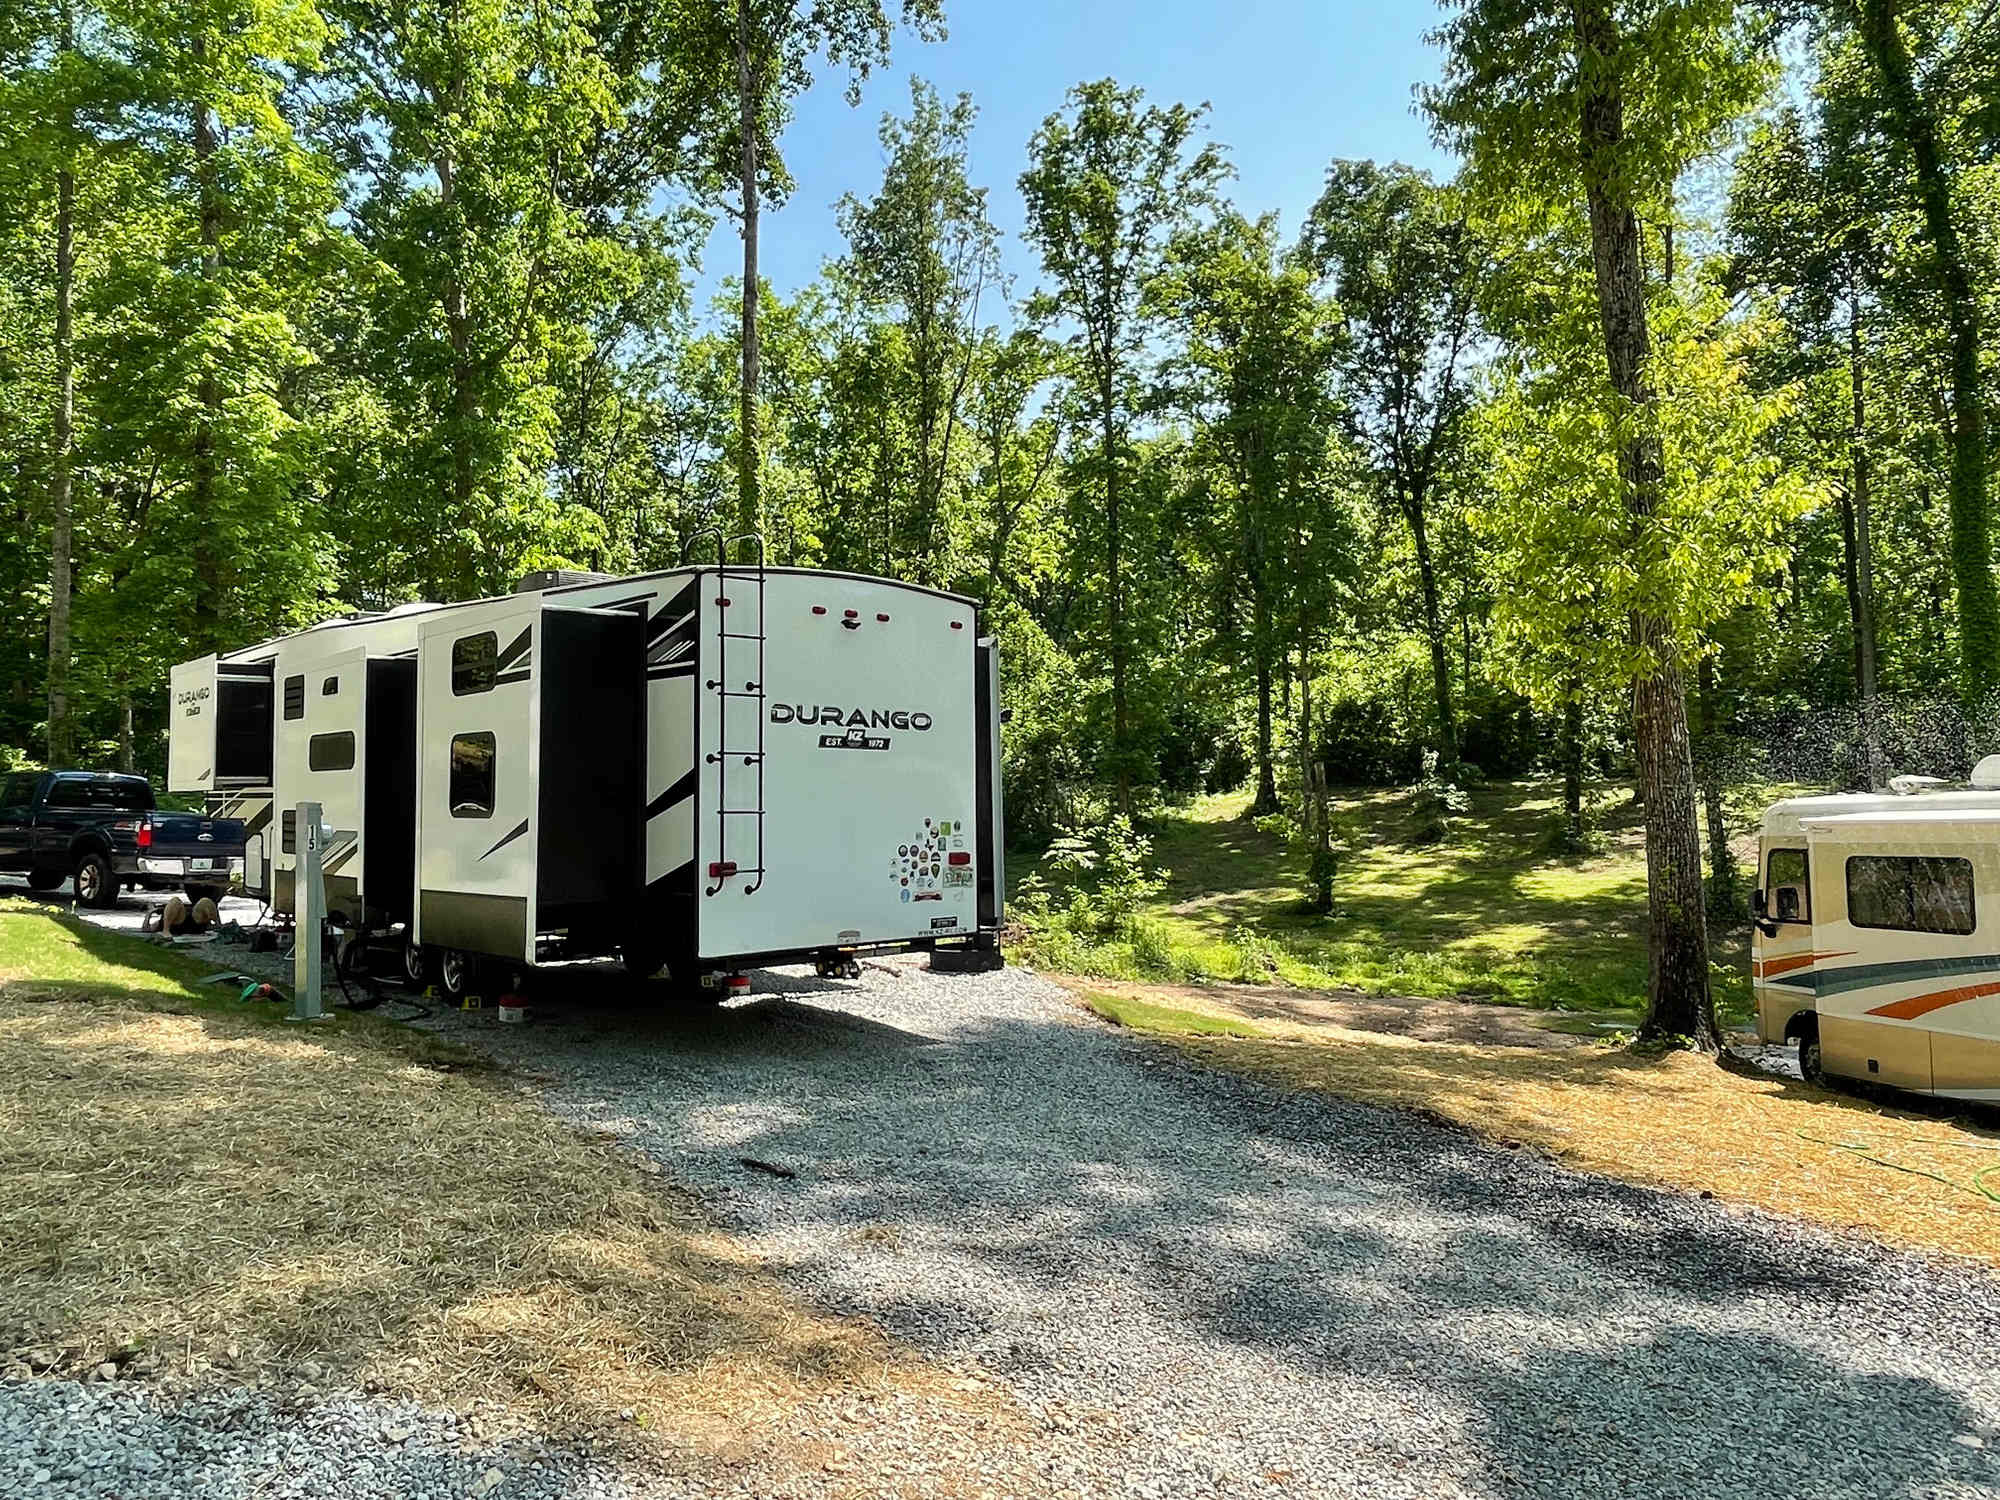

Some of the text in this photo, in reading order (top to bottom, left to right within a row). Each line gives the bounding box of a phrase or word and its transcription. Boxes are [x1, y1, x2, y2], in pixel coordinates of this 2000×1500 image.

[770, 703, 932, 731] DURANGO
[847, 730, 863, 741] KZ
[825, 737, 842, 746] EST.
